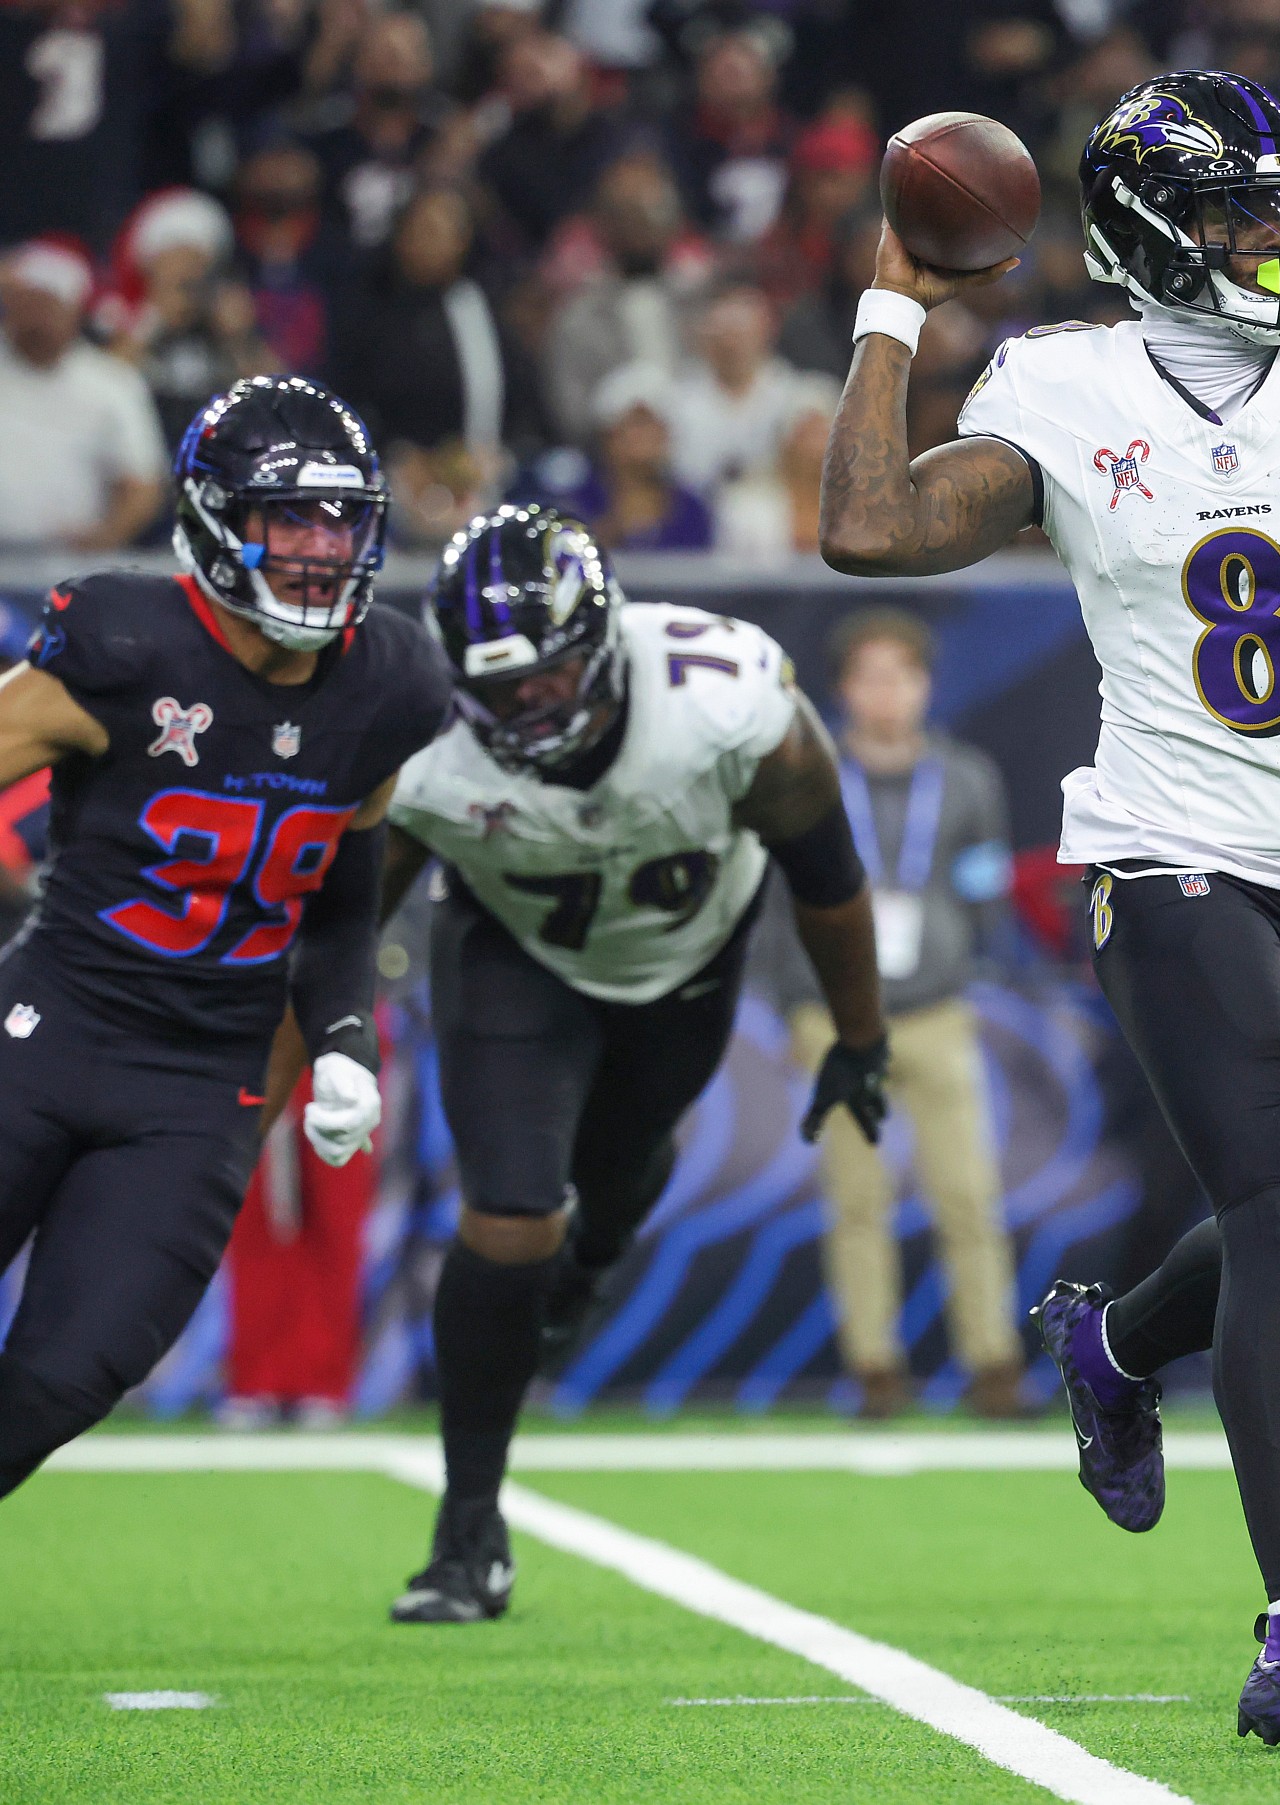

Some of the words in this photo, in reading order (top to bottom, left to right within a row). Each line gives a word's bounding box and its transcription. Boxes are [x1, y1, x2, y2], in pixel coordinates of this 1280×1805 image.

[1215, 456, 1237, 471] NFL
[1115, 469, 1138, 487] NFL
[1196, 504, 1272, 521] RAVENS
[97, 785, 361, 966] 39
[1185, 881, 1207, 895] NFL
[501, 848, 721, 952] 79
